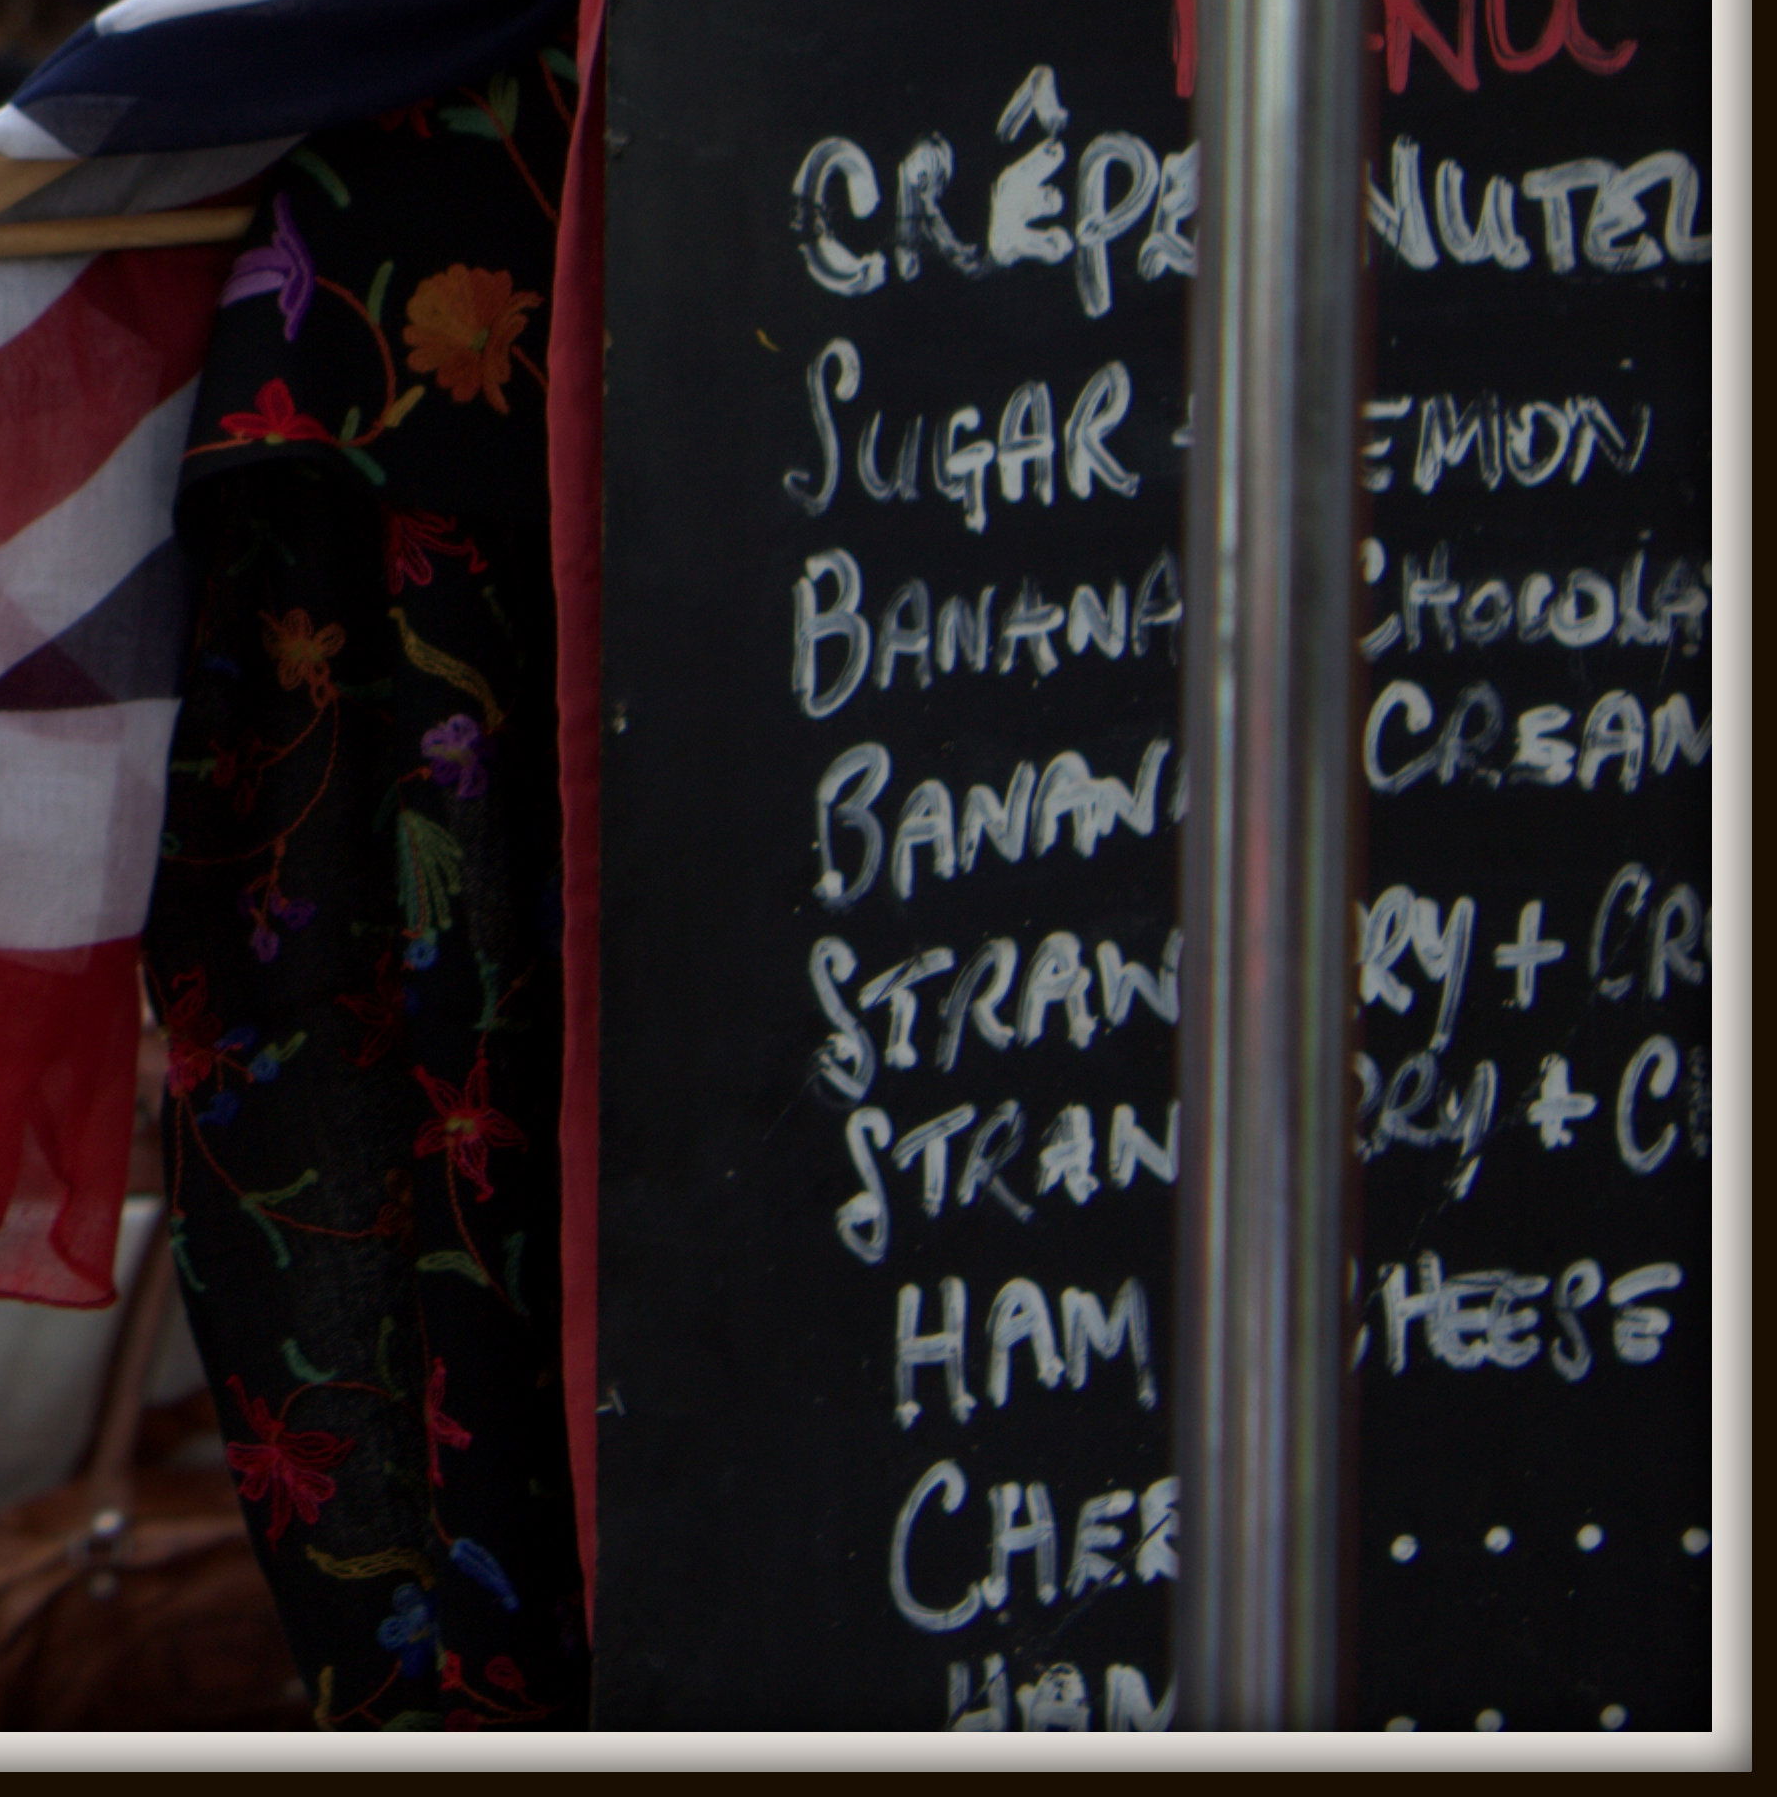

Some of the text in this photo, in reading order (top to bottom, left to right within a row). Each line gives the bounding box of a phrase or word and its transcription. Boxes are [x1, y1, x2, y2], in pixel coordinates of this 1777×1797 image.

[783, 336, 1654, 533] SUGAR EMON
[792, 546, 1183, 719] BANANA
[812, 737, 1190, 913] BANAN
[1587, 861, 1711, 1001] CR
[894, 1249, 1685, 1431] HAM HEESE
